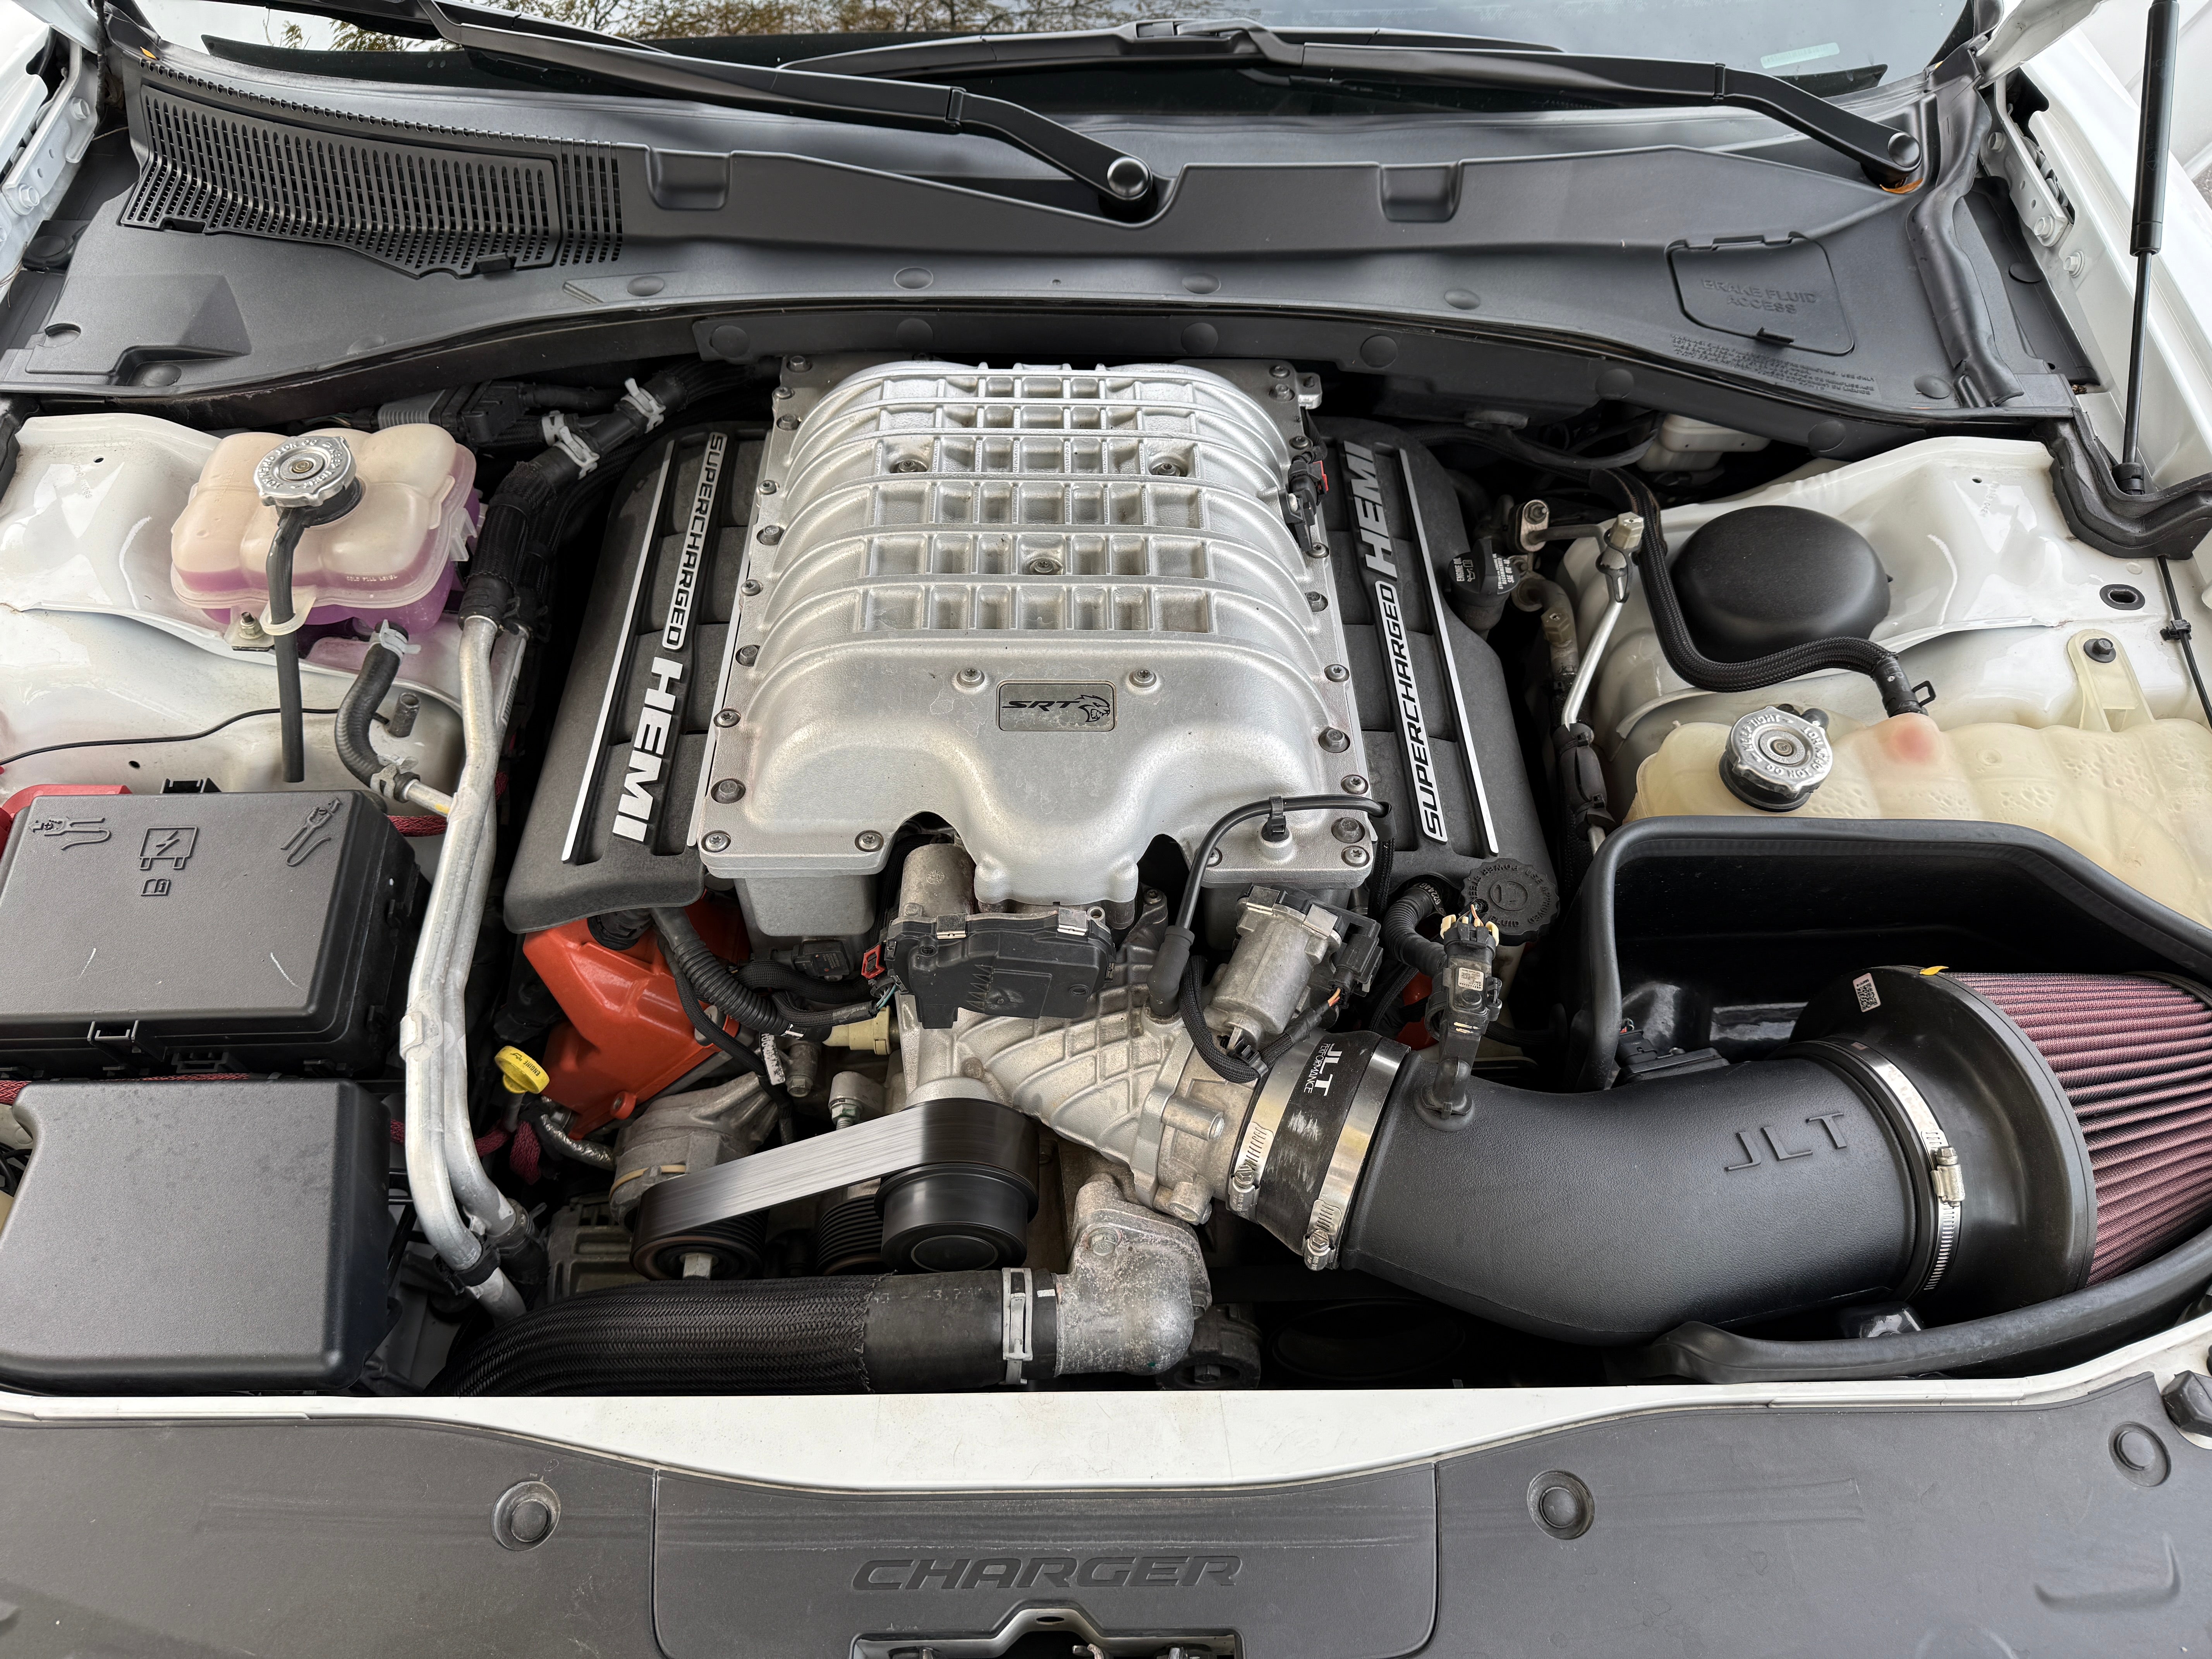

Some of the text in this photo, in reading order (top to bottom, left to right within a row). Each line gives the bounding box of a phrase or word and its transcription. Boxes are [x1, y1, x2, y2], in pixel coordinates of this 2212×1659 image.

[1701, 279, 1817, 304] BRAKE FLUID
[1727, 295, 1797, 314] ACCESS
[1454, 565, 1465, 582] ENGINE
[612, 433, 723, 843] SUPERCHARGED HEMI
[1343, 440, 1444, 838] SUPERCHARGED HEMI
[1001, 701, 1080, 711] SRT
[1740, 714, 1781, 751] KEEP TIGHT
[1764, 763, 1784, 775] DO
[1786, 767, 1813, 778] NOT
[1482, 863, 1519, 876] POWER
[1525, 868, 1551, 924] USE APPROVED
[1489, 915, 1520, 927] FLUID
[523, 1059, 541, 1077] ENGINE
[1304, 1043, 1331, 1094] PERFORMANCE
[1314, 1043, 1343, 1096] JLT
[1724, 1111, 1847, 1172] JLT
[851, 1555, 1244, 1591] CHARGER
